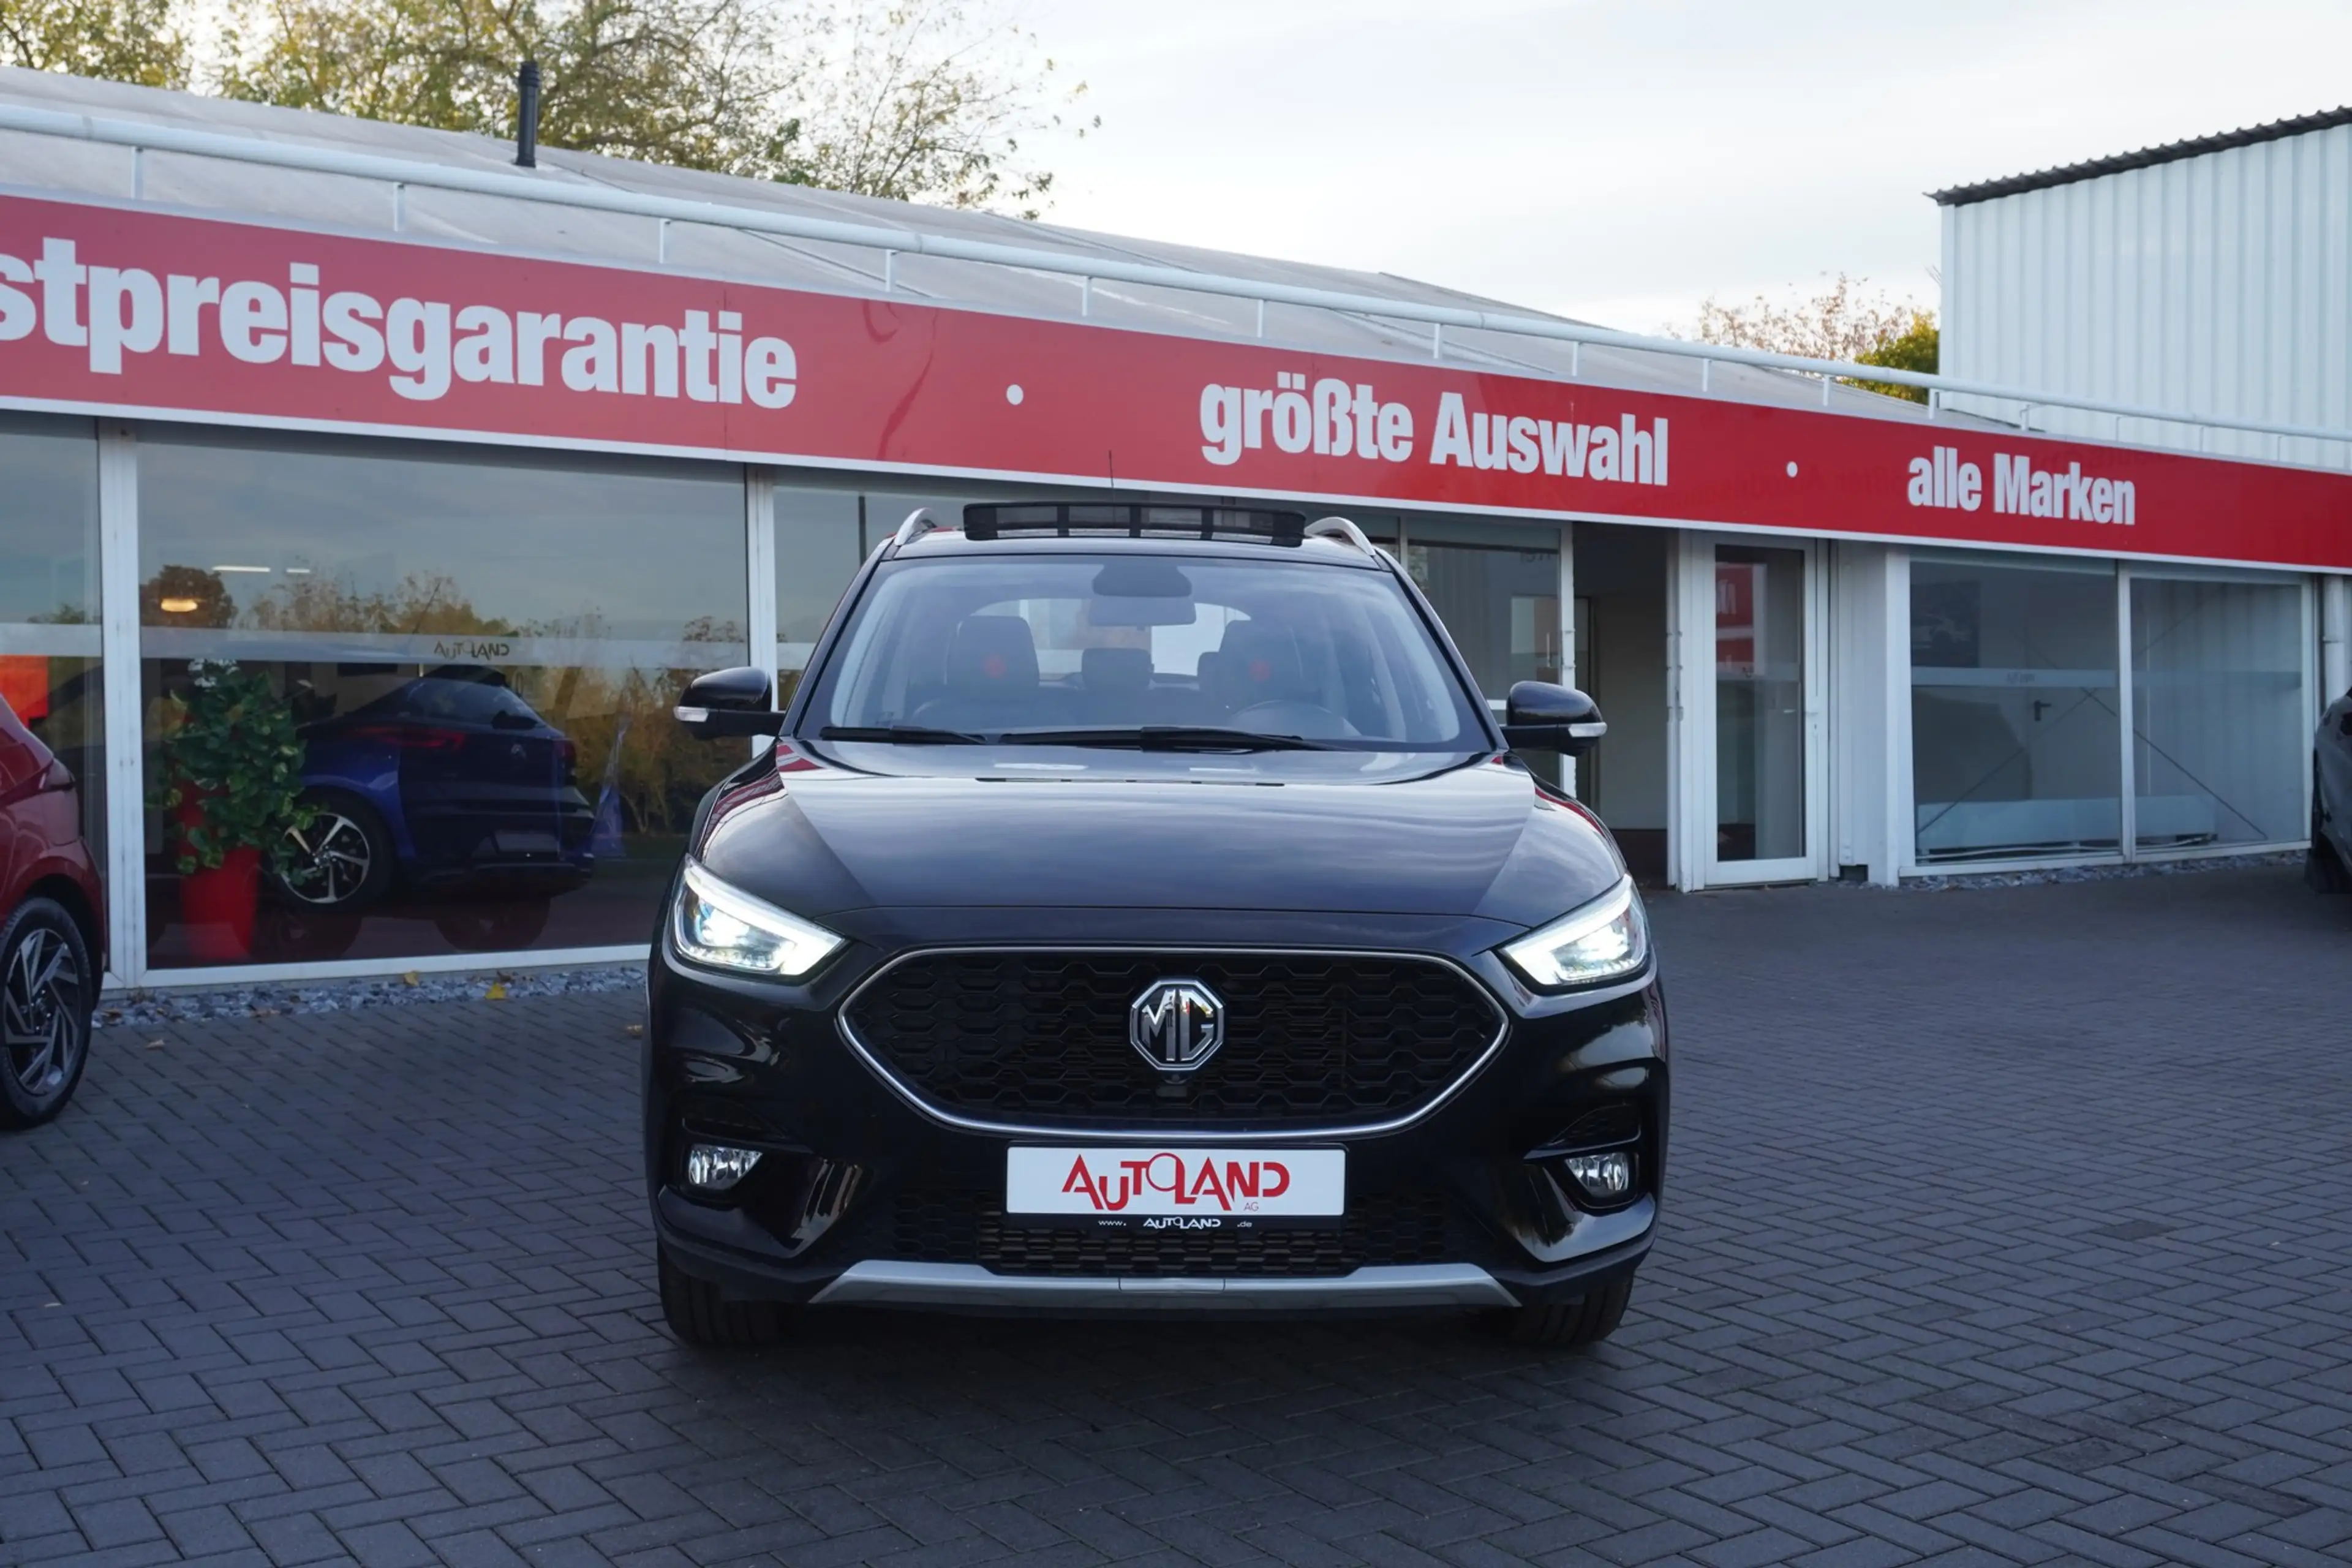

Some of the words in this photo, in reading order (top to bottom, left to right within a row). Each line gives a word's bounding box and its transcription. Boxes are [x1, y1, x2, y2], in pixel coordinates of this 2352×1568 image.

[1199, 371, 1414, 466] größte
[1430, 391, 1669, 486] Auswahl
[1907, 446, 1982, 512] alle
[1994, 453, 2136, 526] Marken
[1140, 989, 1215, 1062] MG
[1243, 1202, 1260, 1212] AG
